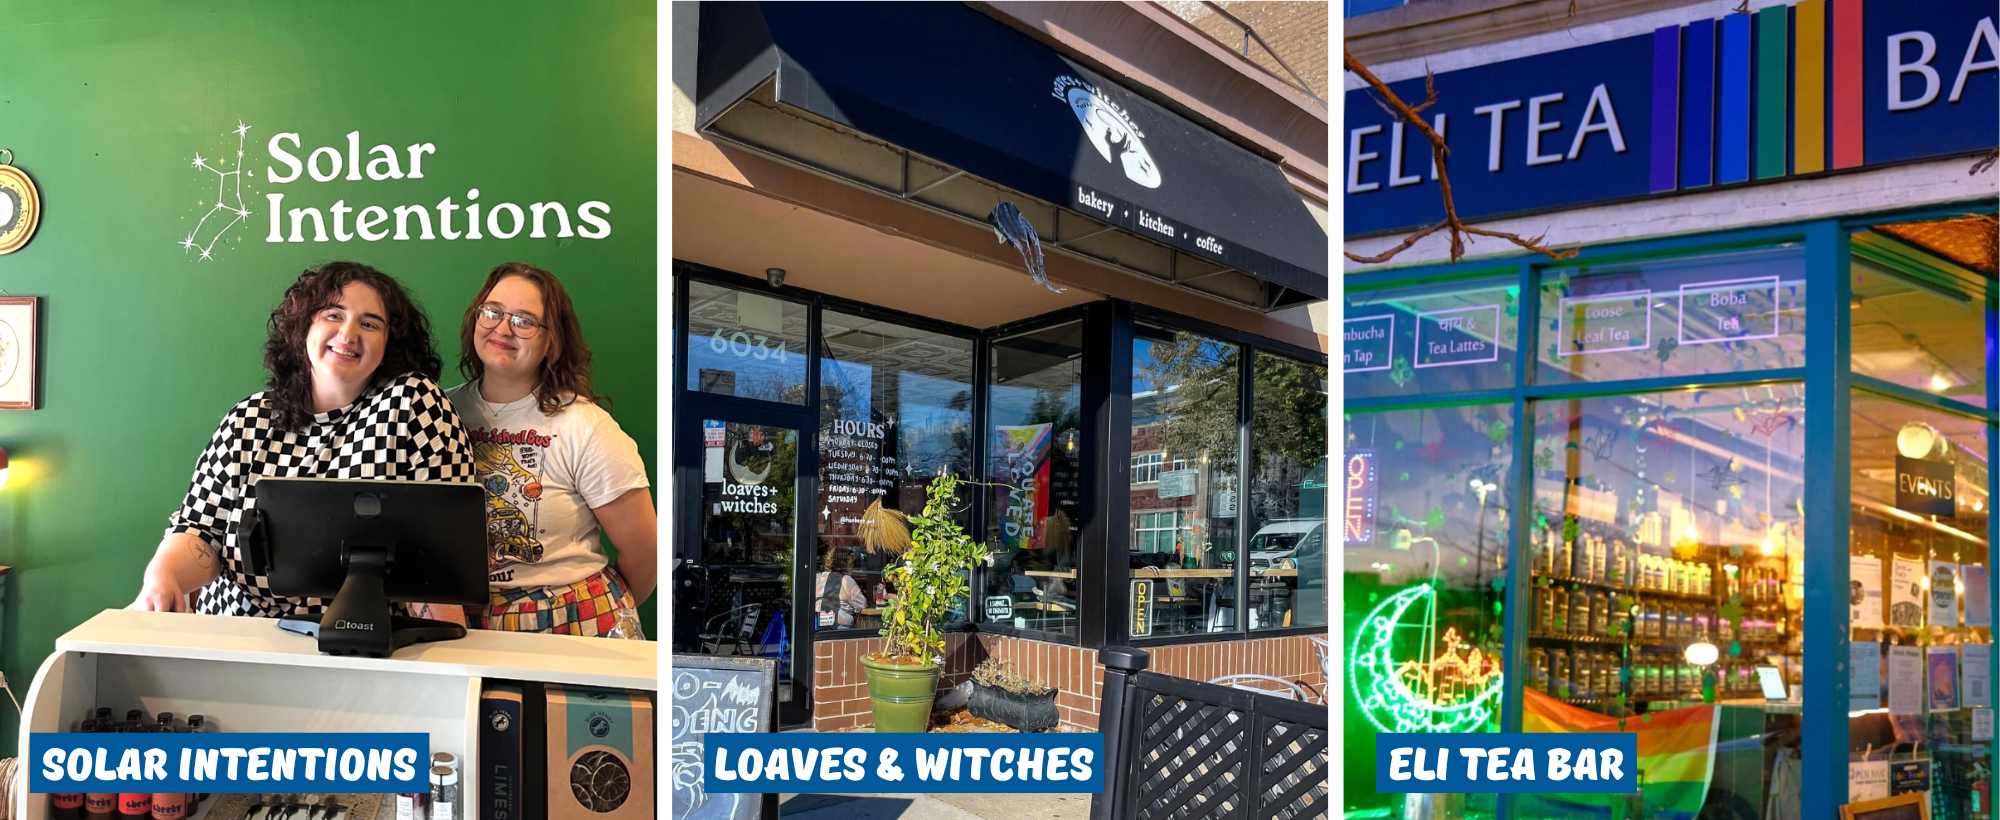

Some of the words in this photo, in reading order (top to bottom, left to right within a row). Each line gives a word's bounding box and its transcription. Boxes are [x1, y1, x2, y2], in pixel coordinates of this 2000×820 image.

[1347, 113, 1446, 193] ELI
[1474, 83, 1626, 172] TEA
[267, 130, 436, 183] Solar
[266, 188, 611, 242] Intentions
[1078, 186, 1115, 218] bakery
[1138, 209, 1174, 237] kitchen
[1196, 235, 1223, 255] coffee
[1711, 290, 1747, 307] Boba
[1586, 306, 1623, 319] Loose
[1716, 316, 1739, 331] Tea
[709, 327, 788, 364] 6034
[1577, 328, 1604, 344] Leaf
[1608, 328, 1630, 341] Tea
[1427, 341, 1447, 355] Tea
[1451, 340, 1485, 354] Lattes
[1354, 350, 1373, 366] Tap
[490, 428, 527, 445] School
[527, 429, 551, 448] Bus
[833, 419, 885, 439] HOURS
[722, 478, 778, 497] loaves+
[1900, 473, 1952, 500] EVENTS
[721, 496, 778, 514] witches
[828, 495, 858, 503] SATURDAY
[1345, 456, 1364, 539] OPEN
[1136, 583, 1147, 634] OPEN
[346, 621, 374, 631] toast
[494, 764, 508, 820] LIMES
